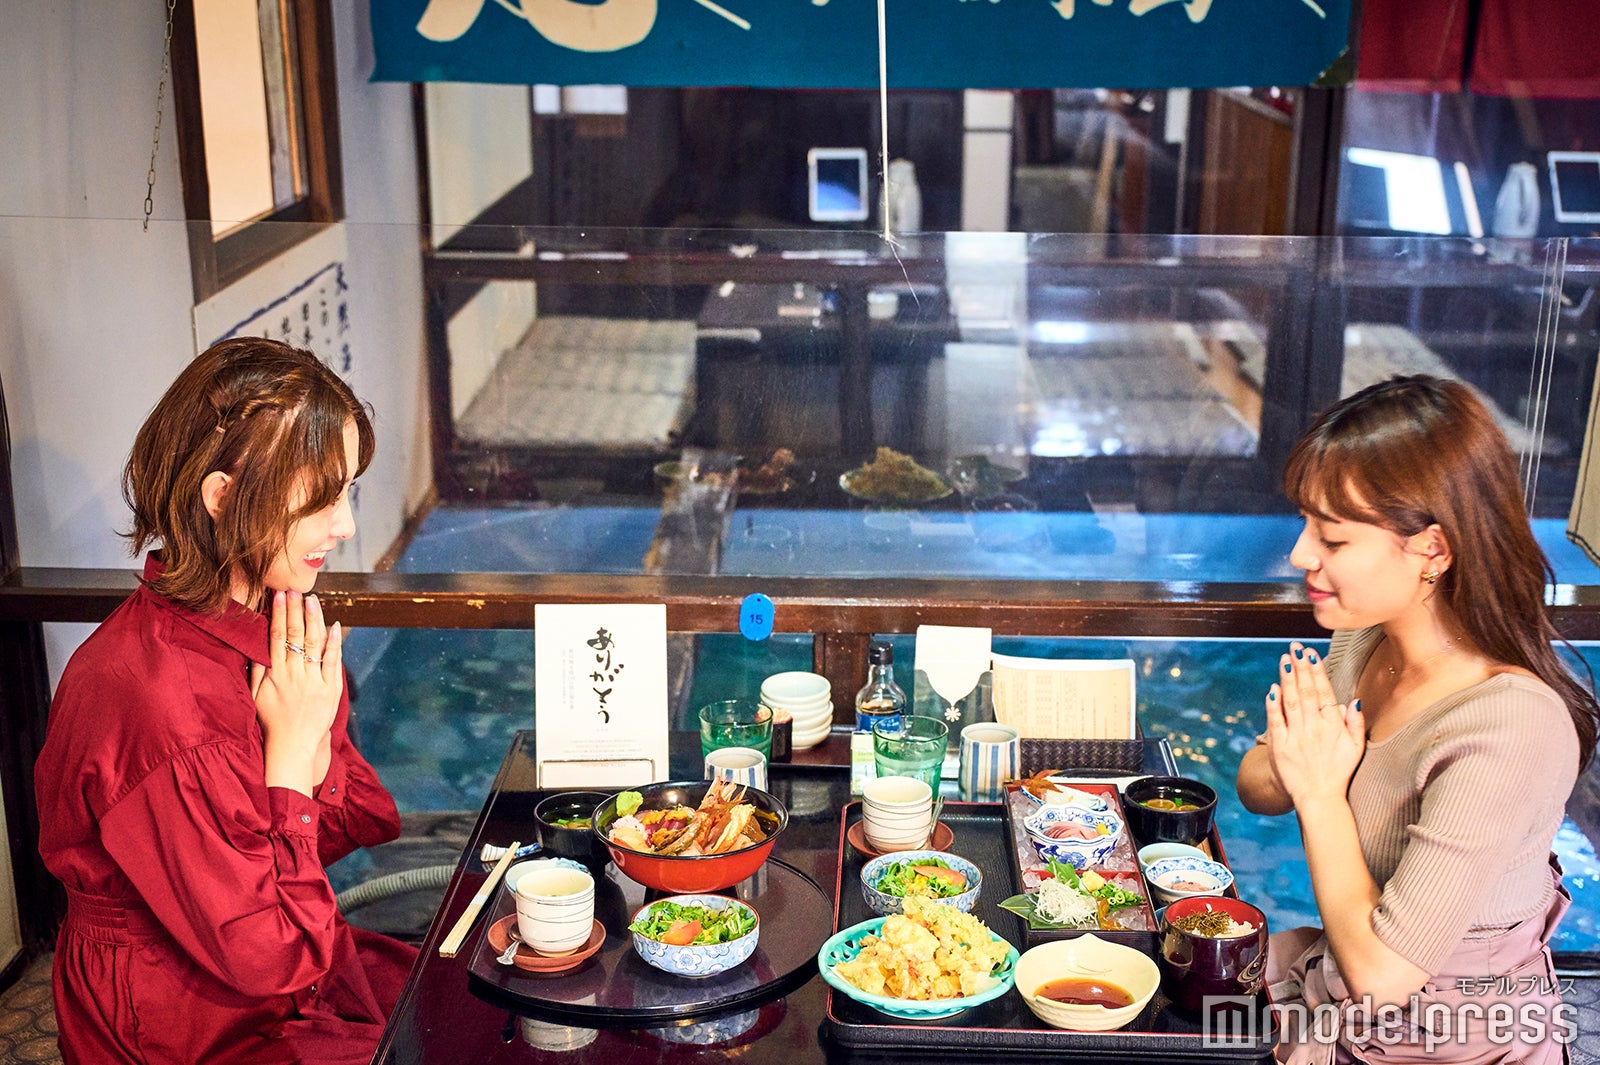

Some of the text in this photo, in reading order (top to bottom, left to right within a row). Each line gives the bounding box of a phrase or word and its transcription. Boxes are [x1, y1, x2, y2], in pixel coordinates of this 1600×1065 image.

[750, 614, 763, 624] 15
[586, 626, 625, 724] ありがとう
